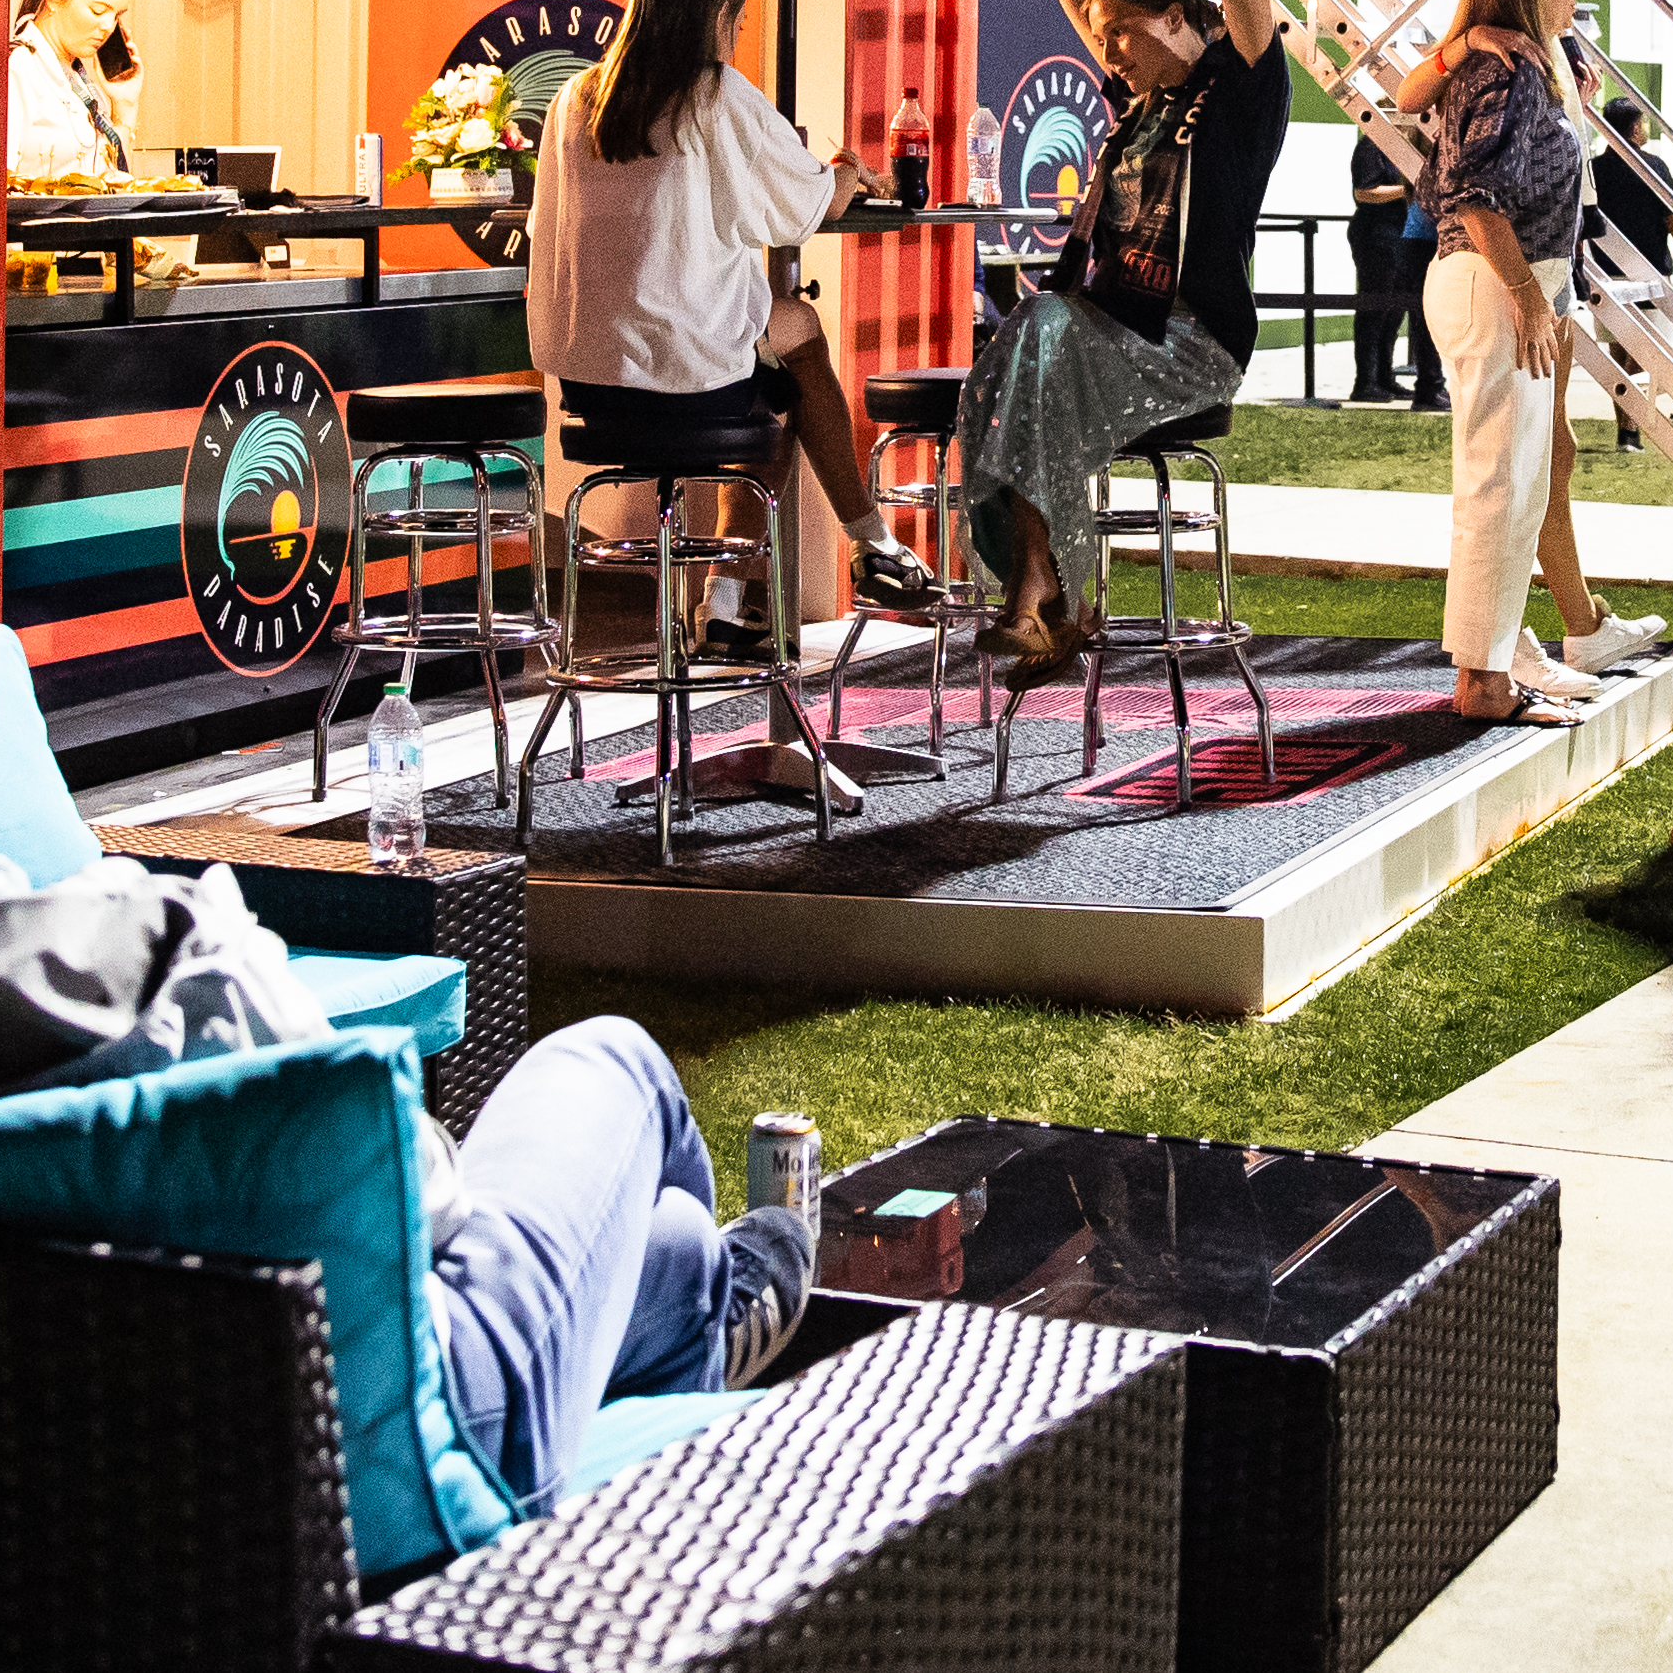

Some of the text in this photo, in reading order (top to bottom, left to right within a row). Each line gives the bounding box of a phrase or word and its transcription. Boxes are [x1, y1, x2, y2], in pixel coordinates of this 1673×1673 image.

[479, 6, 614, 63] ARASO
[1012, 71, 1106, 137] SARASOTA
[358, 153, 367, 194] ULTRA
[203, 362, 335, 459] SARASOTA
[203, 552, 335, 654] PARADISE
